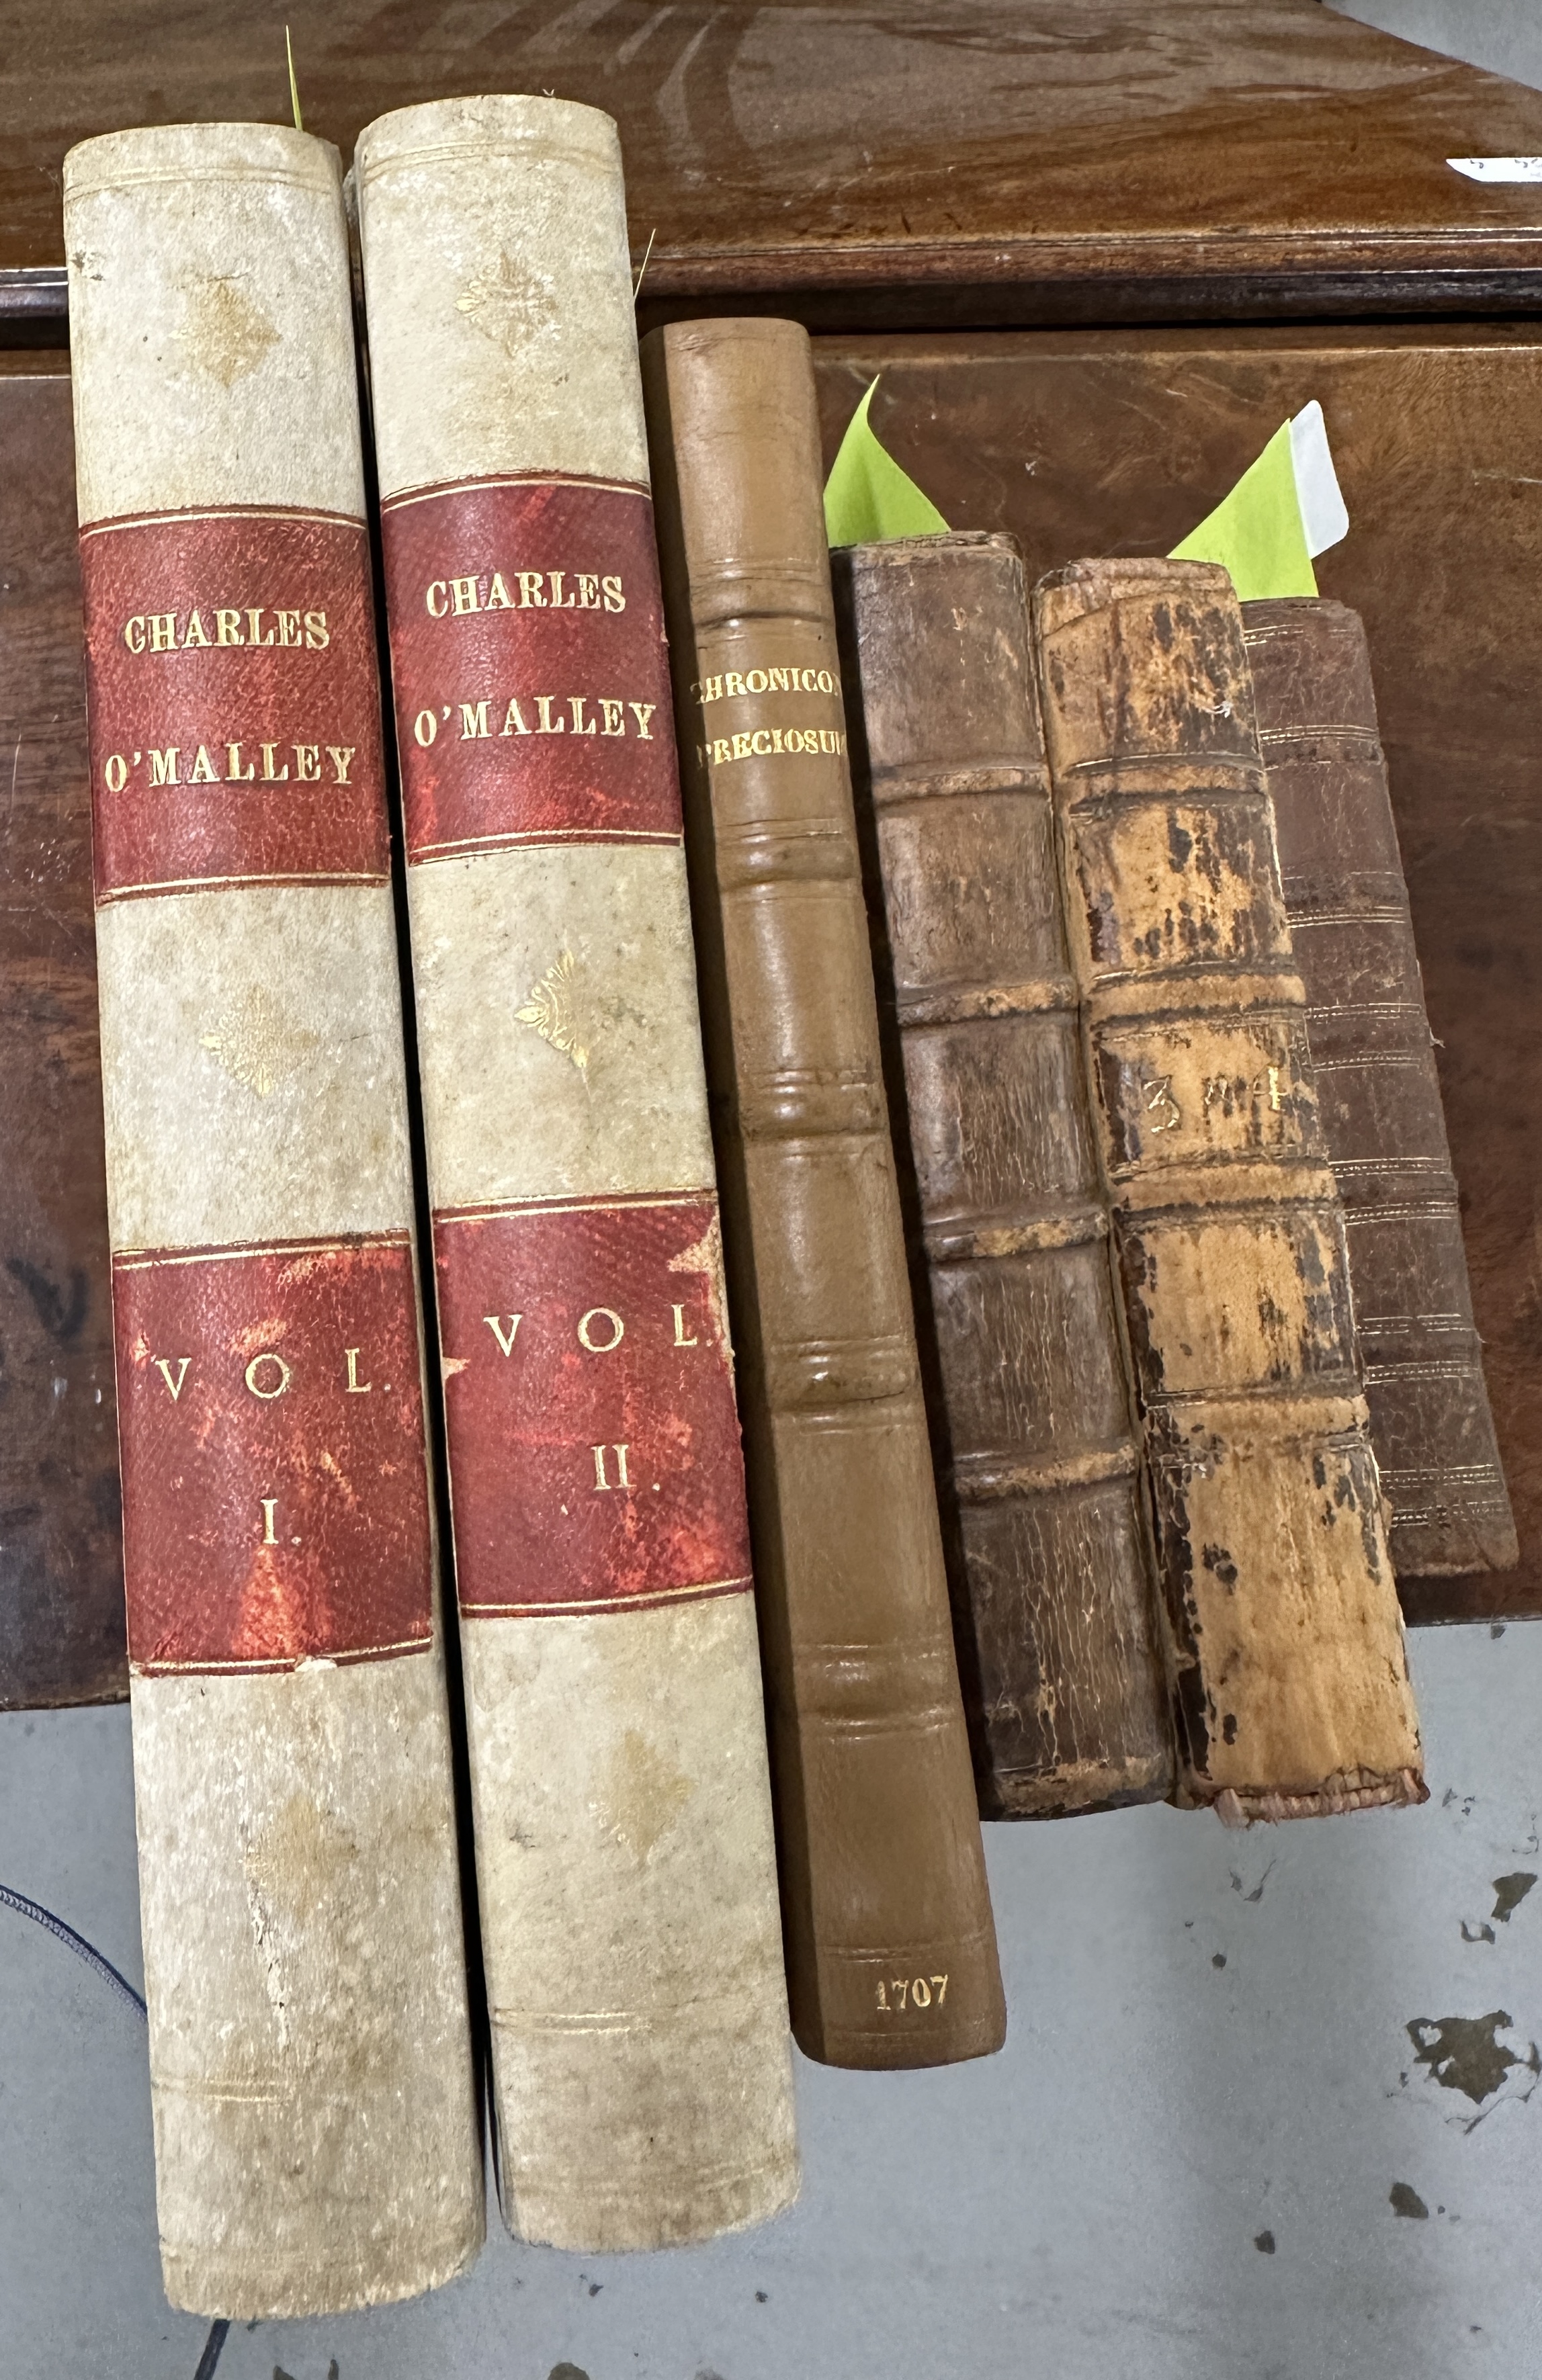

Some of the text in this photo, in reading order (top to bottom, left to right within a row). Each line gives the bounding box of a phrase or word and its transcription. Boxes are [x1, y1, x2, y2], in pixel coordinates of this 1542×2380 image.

[427, 570, 627, 618] CHARLES
[124, 607, 330, 654] CHARLES
[415, 695, 657, 747] O'MALLEY
[105, 741, 356, 793] O'MALLEY
[875, 1974, 948, 2011] 1707
